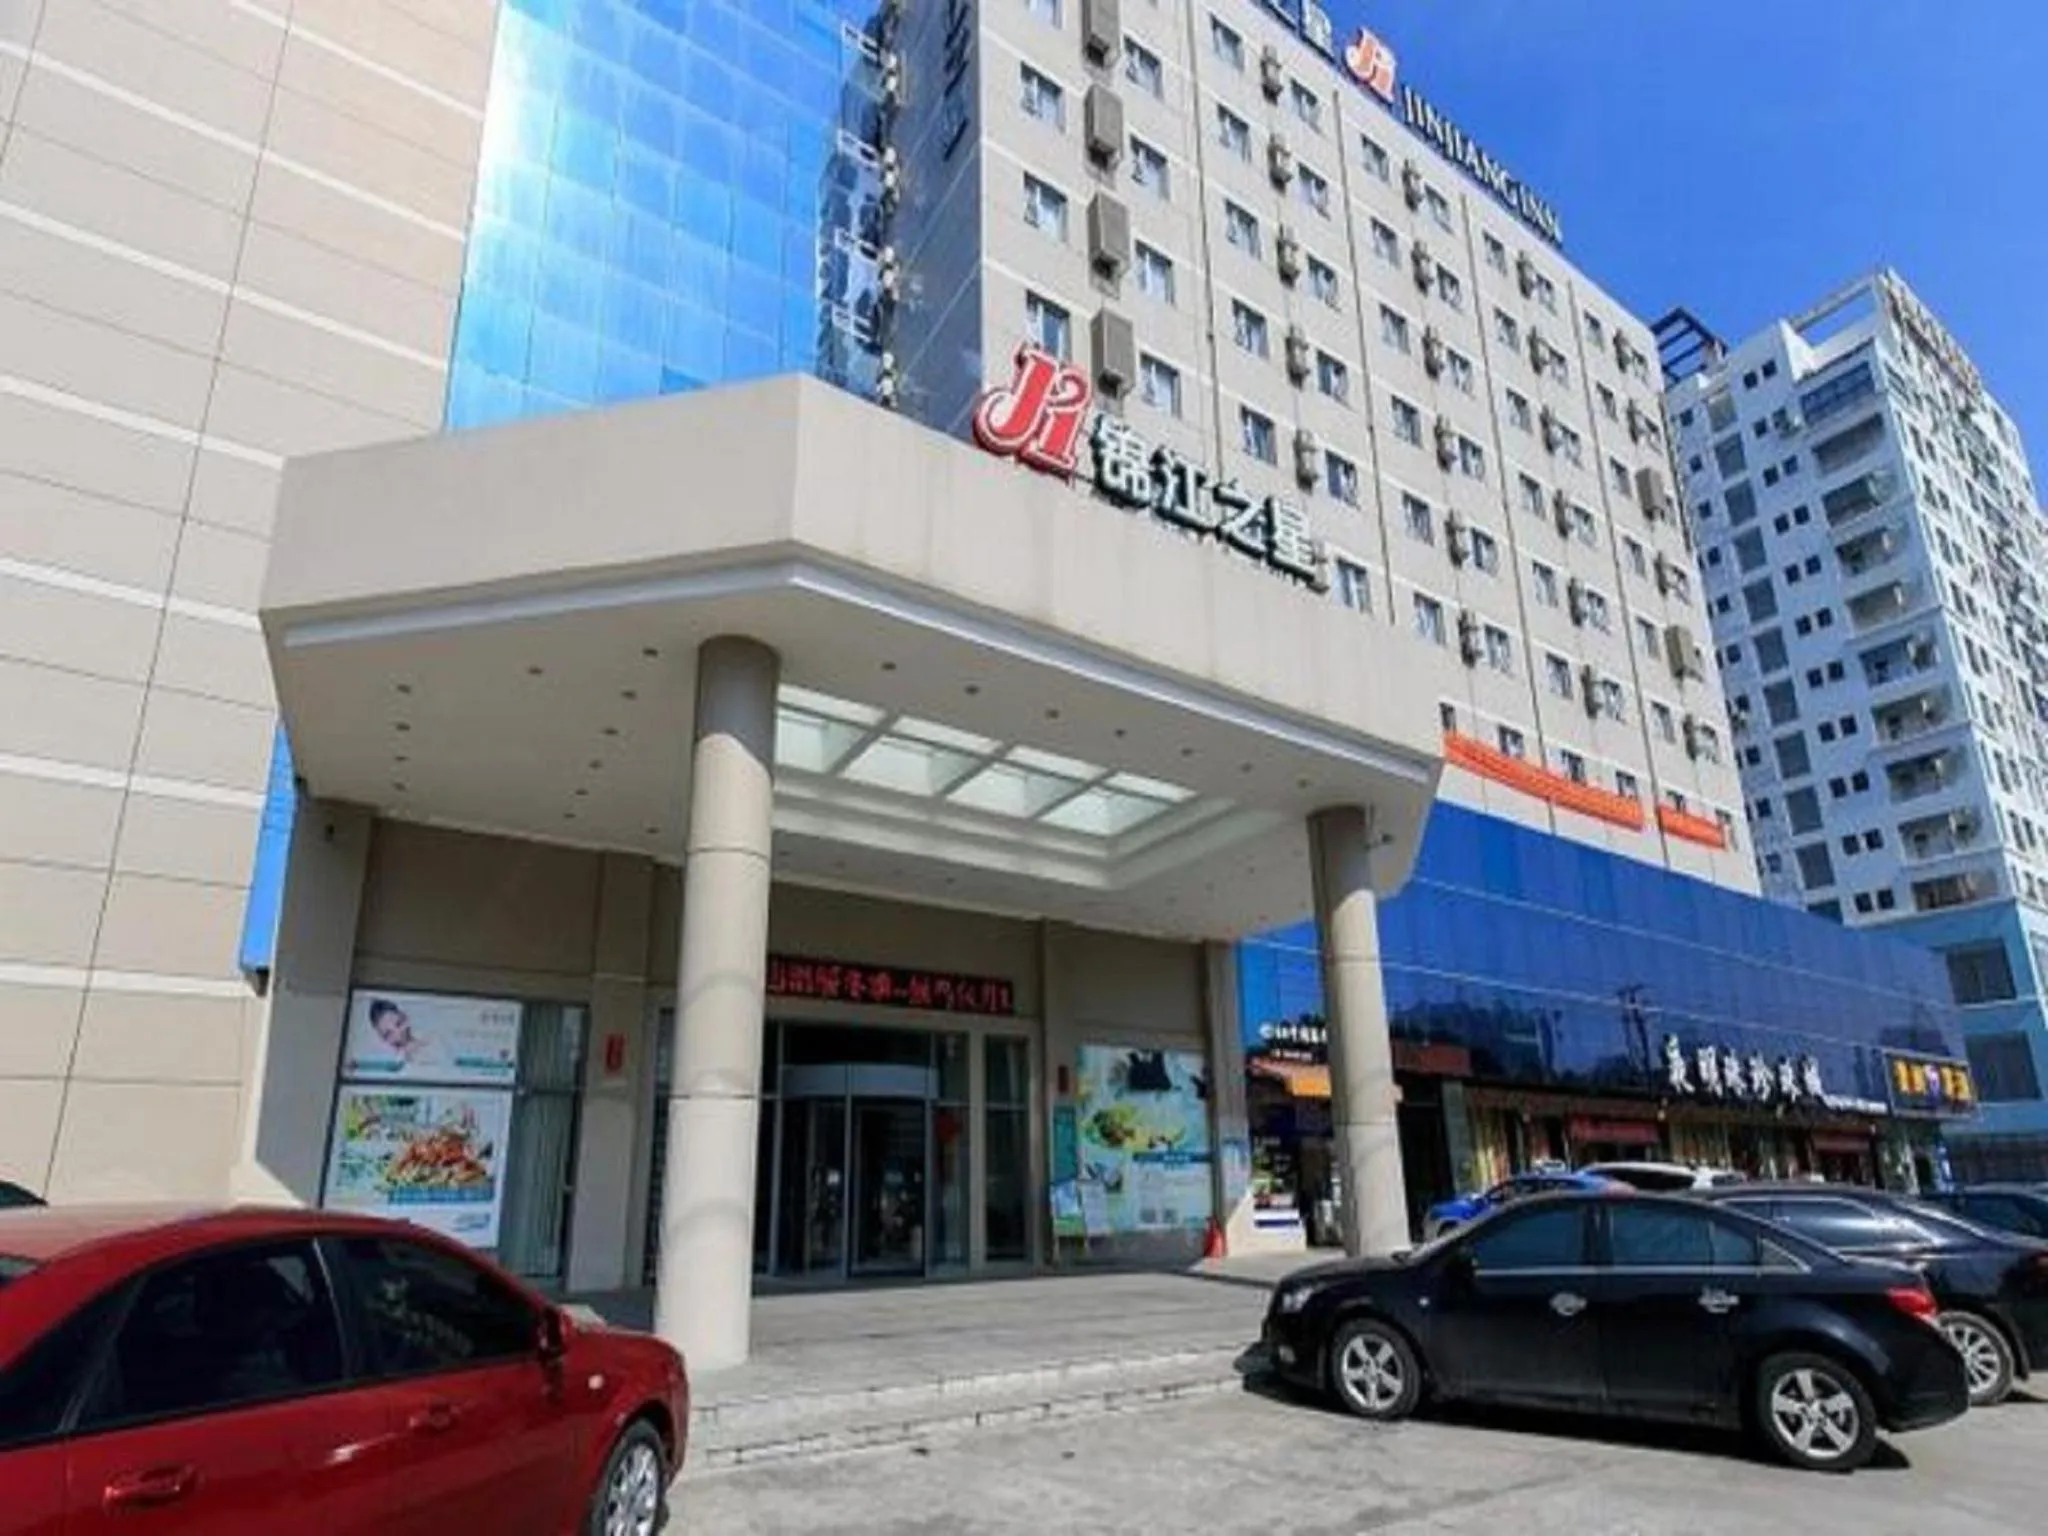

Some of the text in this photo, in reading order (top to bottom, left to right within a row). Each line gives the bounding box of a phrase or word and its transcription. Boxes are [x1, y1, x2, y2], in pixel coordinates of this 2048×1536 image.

[1403, 83, 1518, 206] JINJIANG
[1093, 411, 1320, 583] 锦江之星
